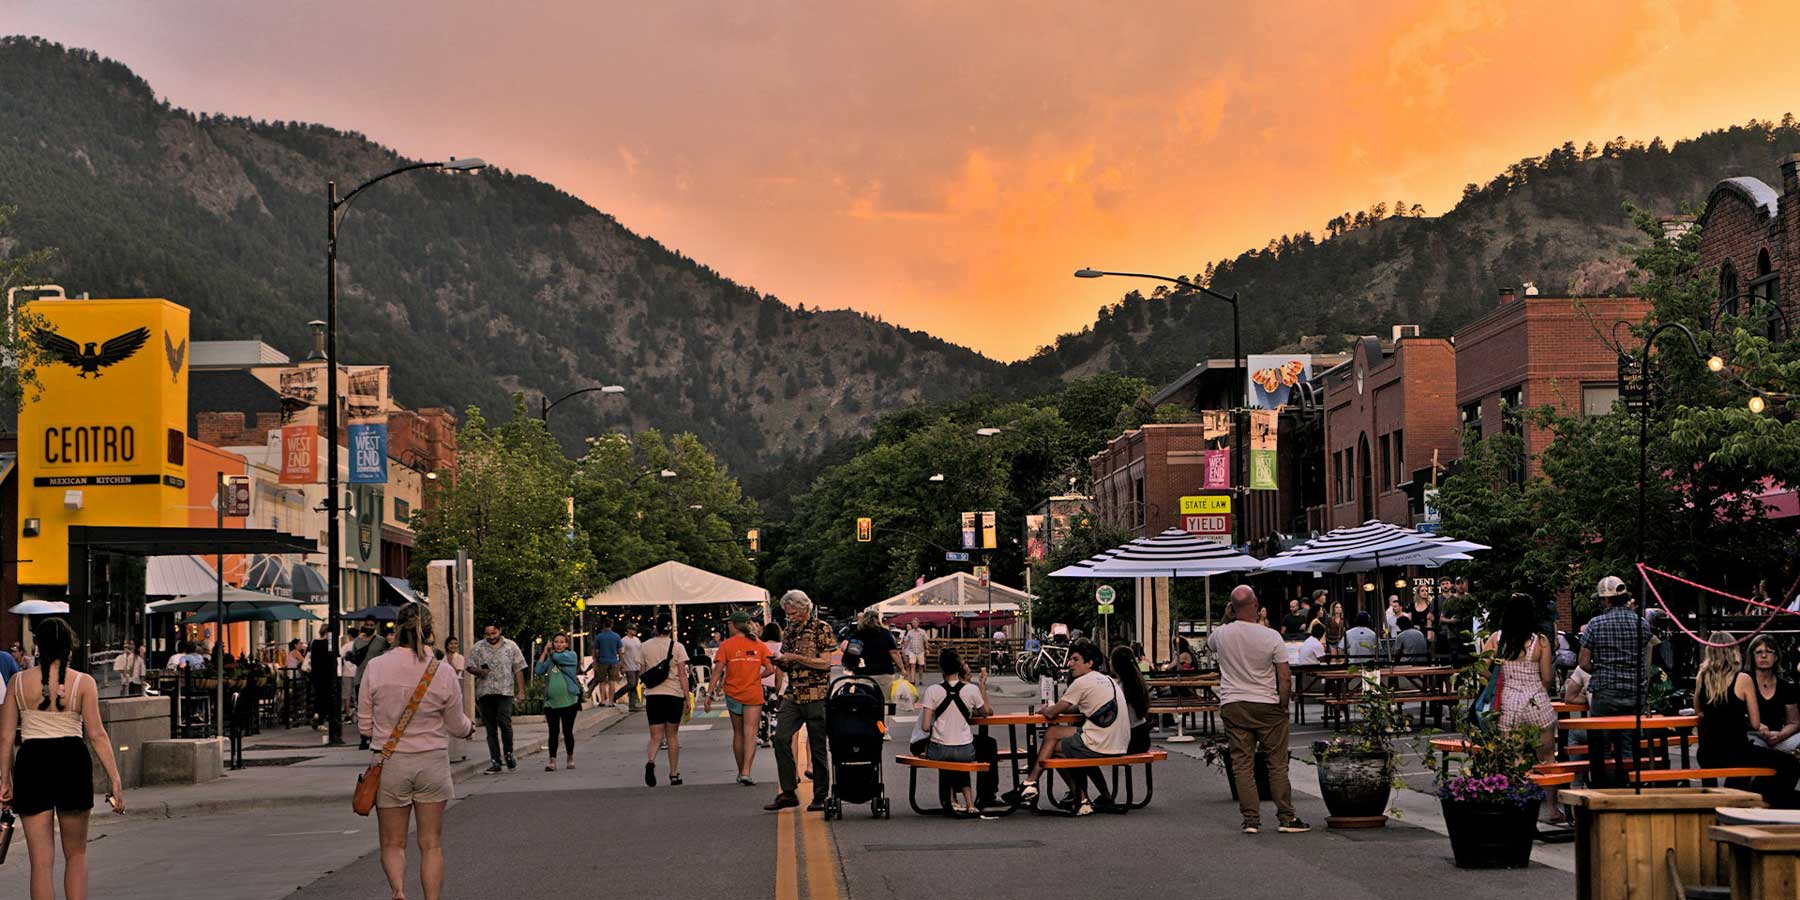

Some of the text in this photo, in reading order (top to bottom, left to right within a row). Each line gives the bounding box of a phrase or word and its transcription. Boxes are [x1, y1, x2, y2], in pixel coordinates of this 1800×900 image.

[45, 425, 134, 463] CENTRO
[287, 437, 312, 451] WEST
[355, 436, 381, 450] WEST
[287, 451, 310, 468] END
[356, 450, 380, 467] END
[1208, 457, 1226, 468] WEST
[96, 476, 132, 484] KITCHEN
[1209, 467, 1225, 480] END
[1184, 501, 1226, 510] STATE LAW
[1188, 518, 1224, 531] YIELD
